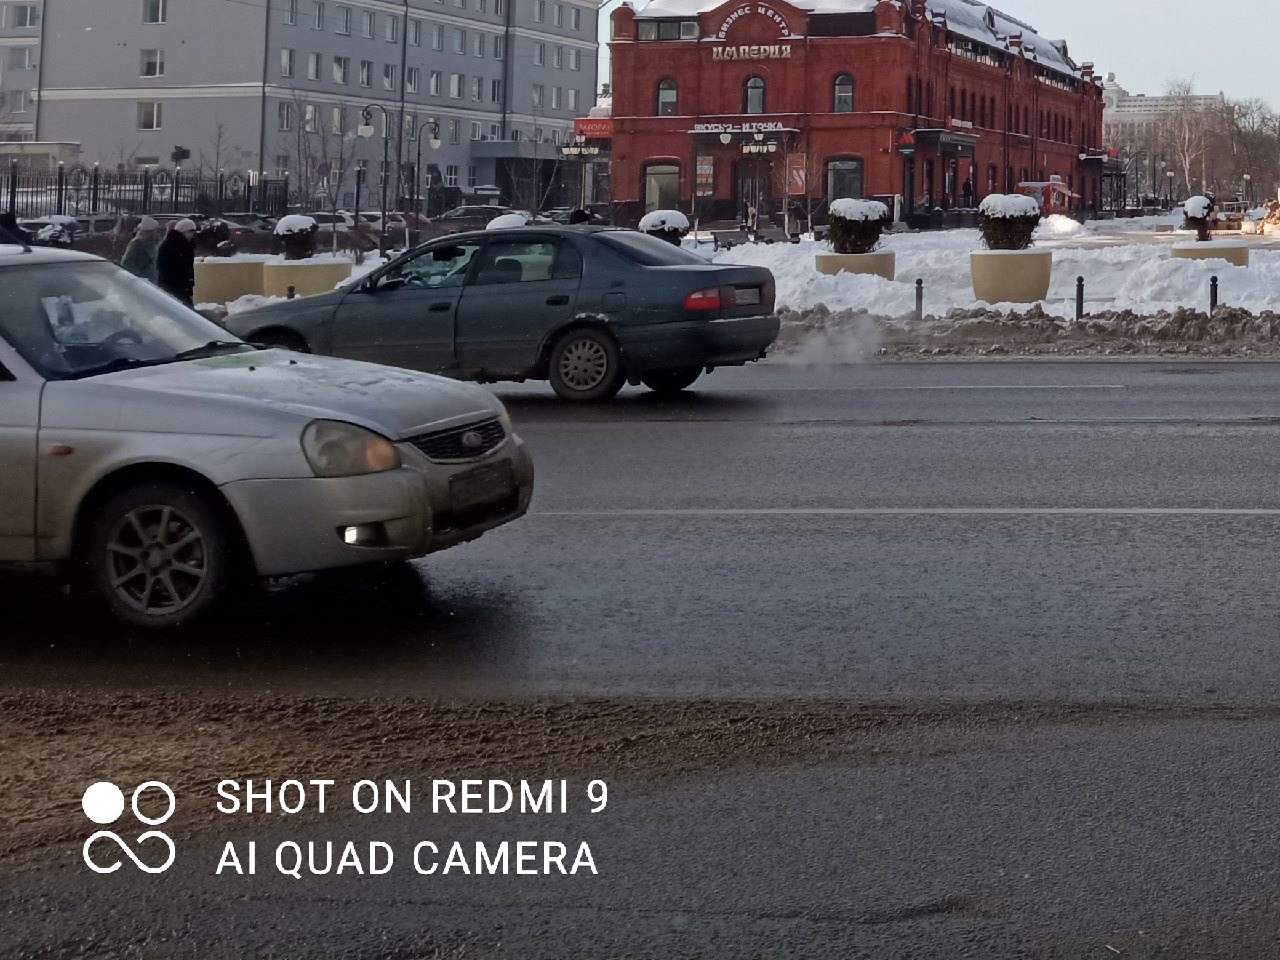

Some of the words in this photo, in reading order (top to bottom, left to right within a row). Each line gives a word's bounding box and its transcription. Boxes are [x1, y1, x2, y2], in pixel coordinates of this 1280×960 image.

[718, 6, 751, 39] БИЗНЕС
[757, 6, 789, 36] ЦЕНТР
[712, 44, 791, 60] ИМПЕРИЯ
[742, 122, 751, 132] И
[751, 122, 784, 131] ТОЧКА
